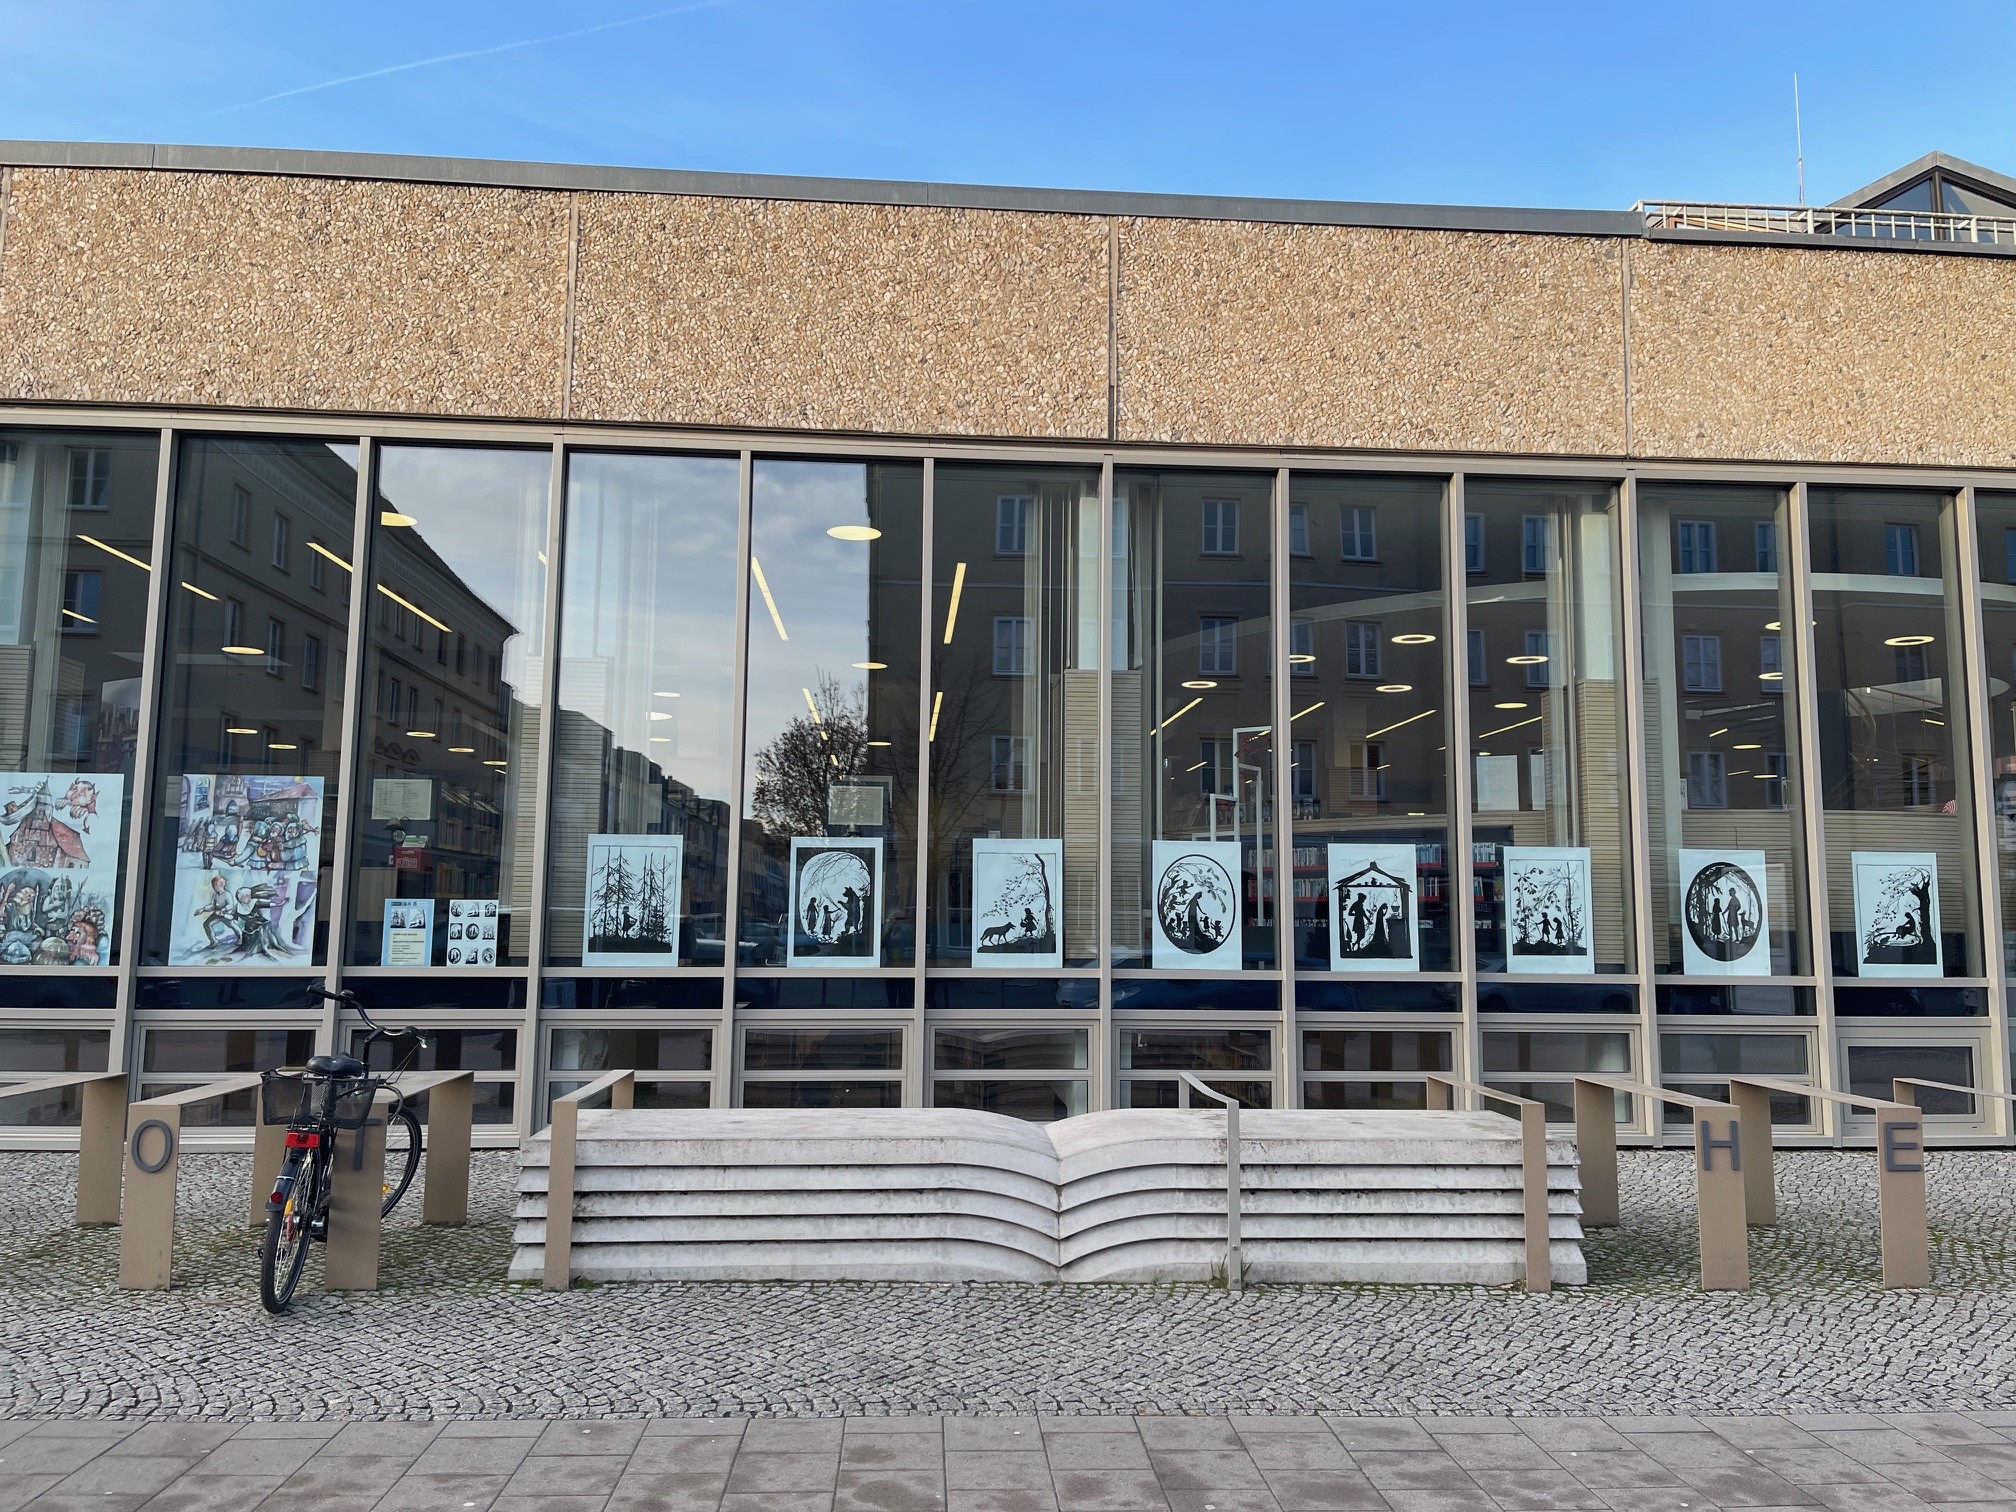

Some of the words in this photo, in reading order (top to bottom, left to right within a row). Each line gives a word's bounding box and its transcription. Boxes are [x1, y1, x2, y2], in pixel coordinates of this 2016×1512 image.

[131, 1119, 173, 1173] O
[1701, 1120, 1740, 1171] H
[1884, 1121, 1922, 1172] E
